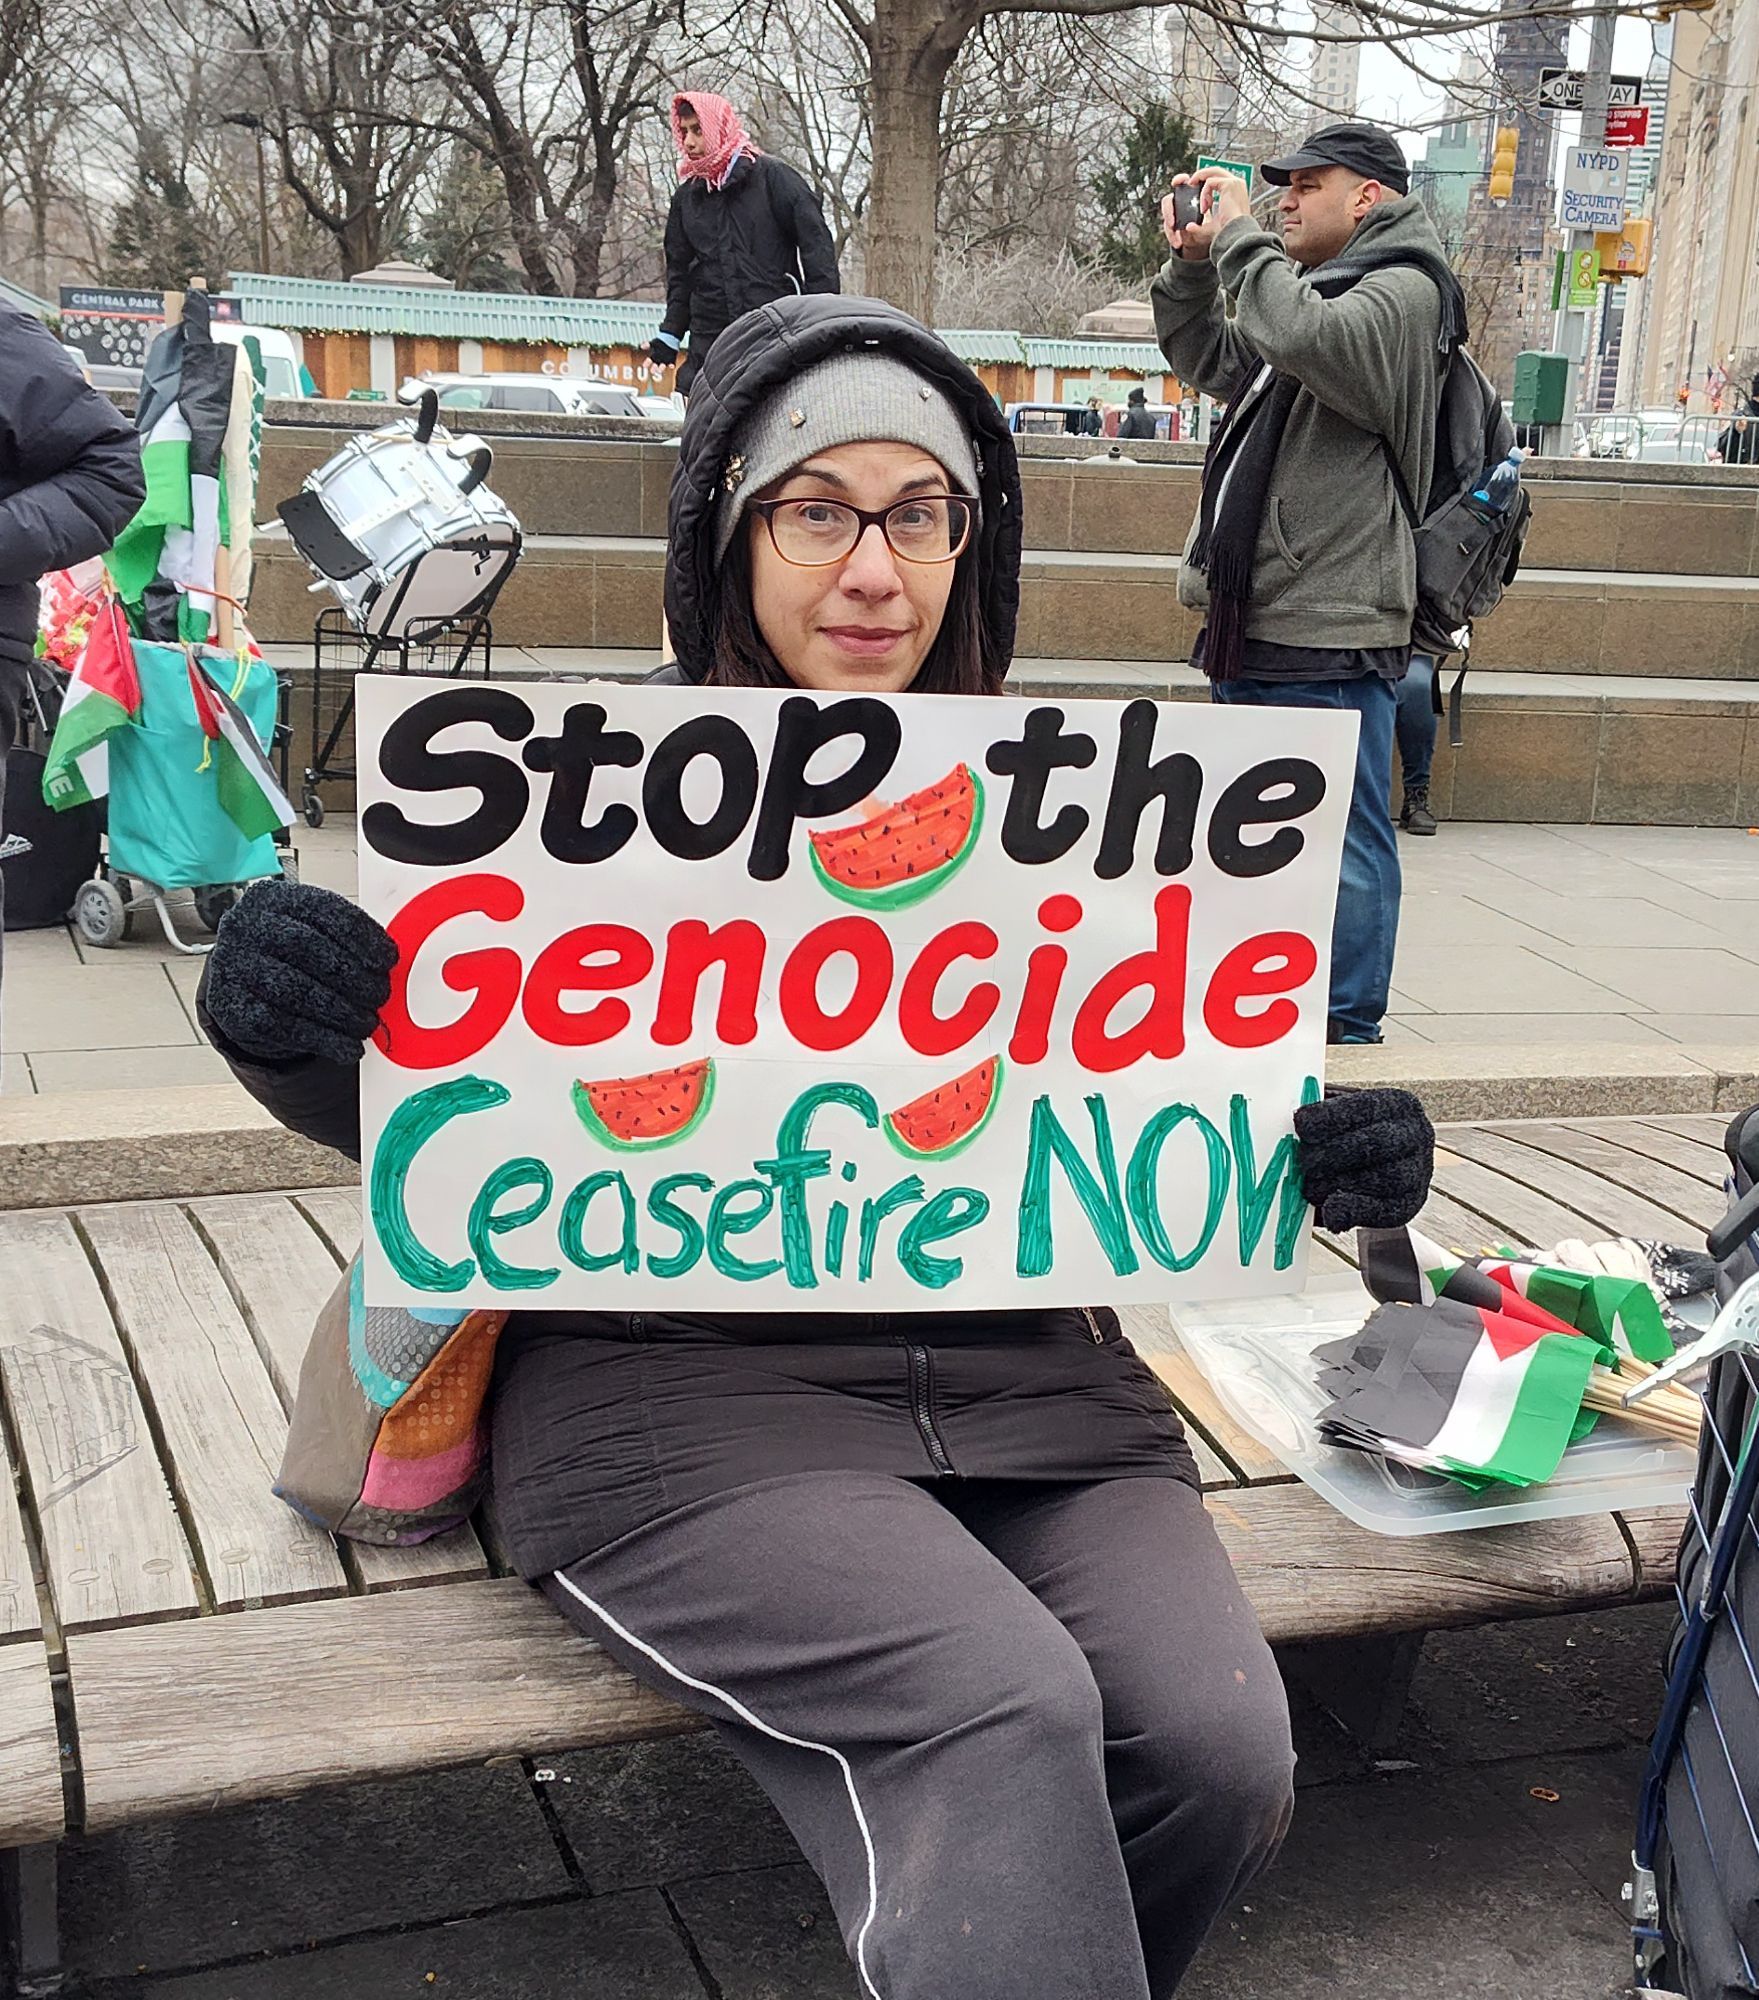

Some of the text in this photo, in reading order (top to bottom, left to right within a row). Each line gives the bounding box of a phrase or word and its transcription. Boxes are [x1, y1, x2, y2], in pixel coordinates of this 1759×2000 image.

[1553, 82, 1584, 98] ONE
[1576, 152, 1619, 171] NYPD
[1563, 189, 1623, 210] SECURITY
[1565, 206, 1618, 226] CAMERA
[71, 293, 127, 307] CENTRAL
[128, 297, 159, 309] PARK
[541, 360, 663, 383] COUMBUS
[362, 686, 1328, 882] Stop the
[371, 873, 1318, 1070] Genocide
[369, 1072, 1322, 1293] Ceasefire NOW
